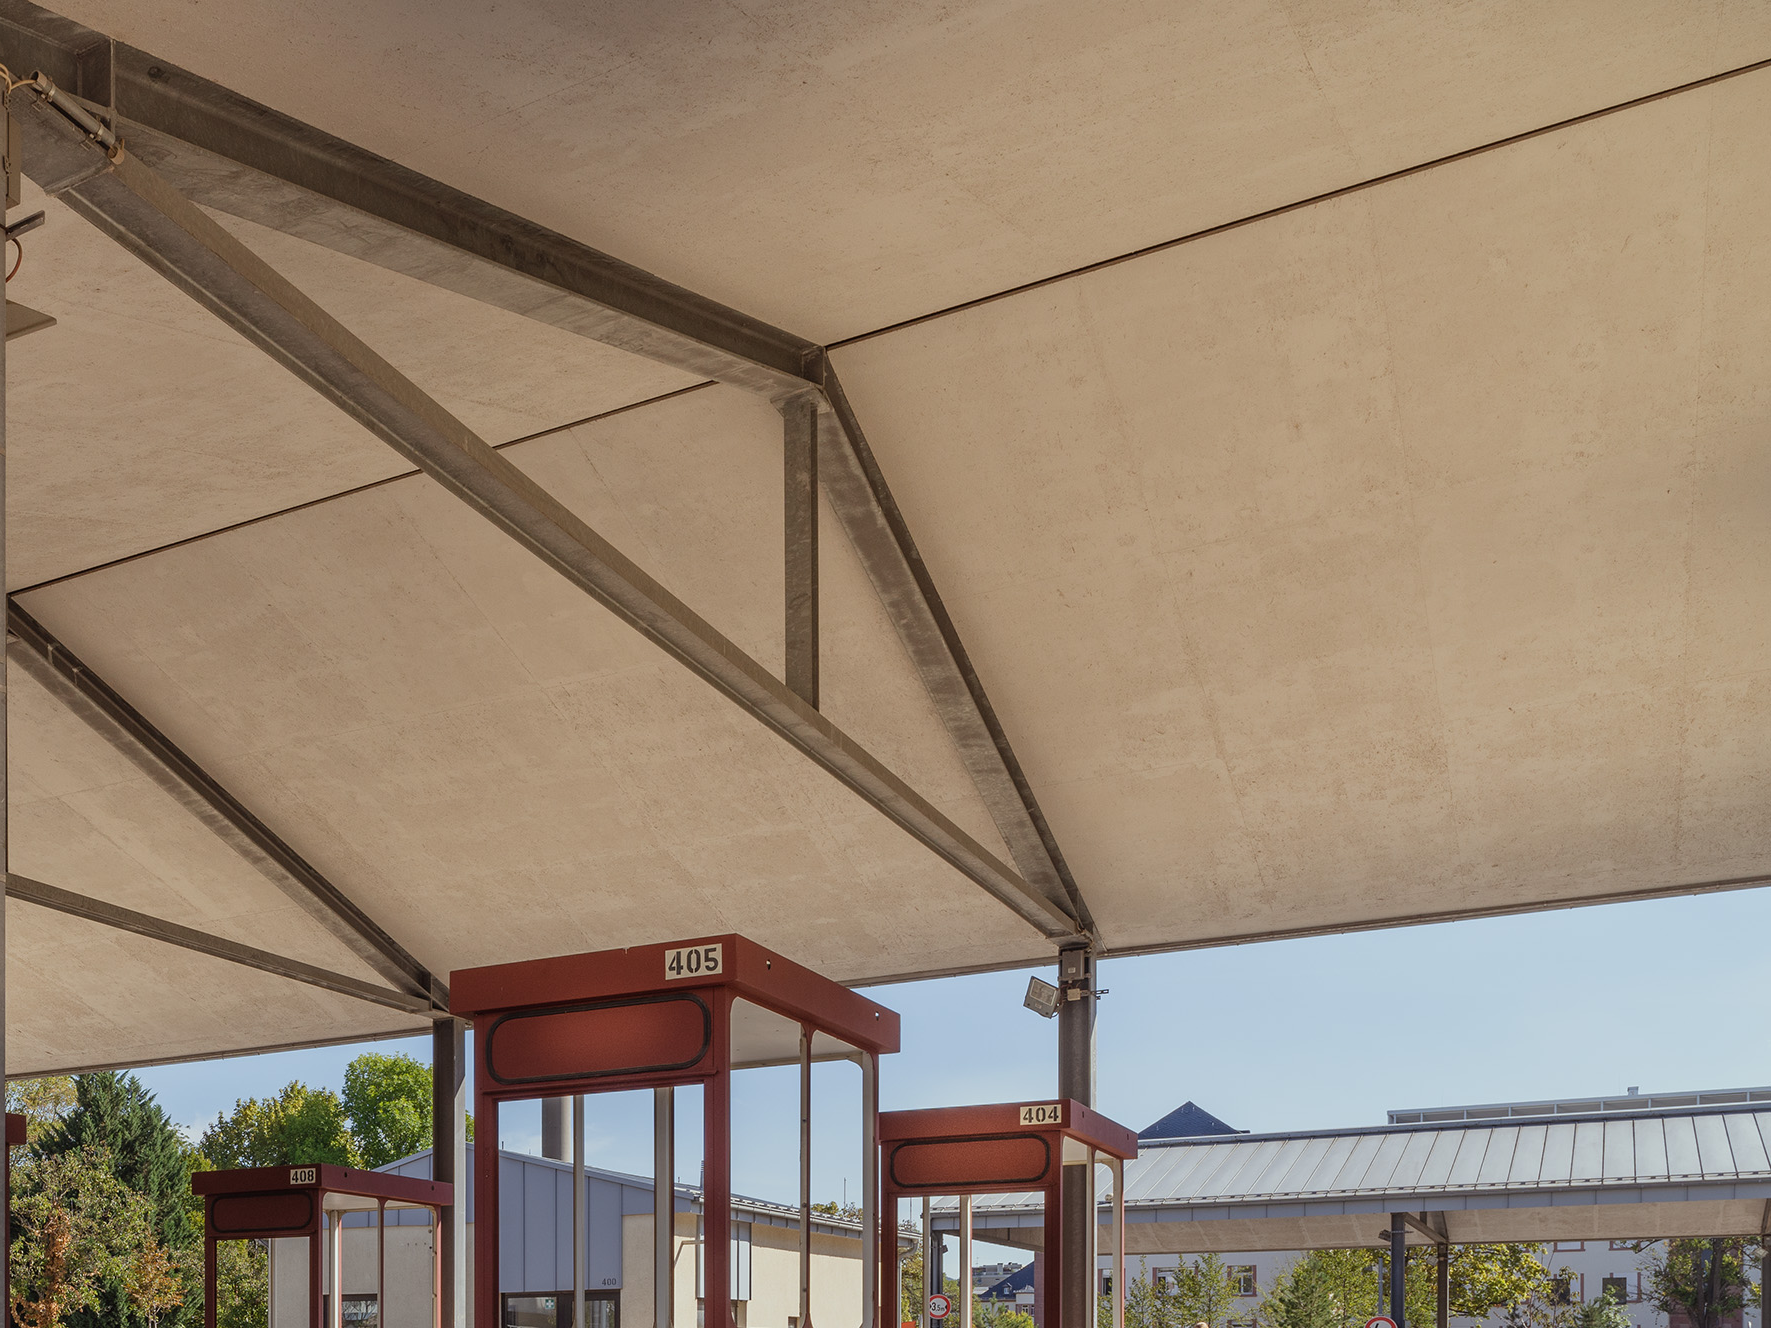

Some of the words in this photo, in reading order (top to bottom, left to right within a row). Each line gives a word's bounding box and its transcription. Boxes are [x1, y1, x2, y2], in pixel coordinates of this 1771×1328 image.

[668, 947, 719, 975] 405
[1023, 1106, 1059, 1123] 404
[292, 1170, 314, 1183] 408
[601, 1277, 617, 1286] 400
